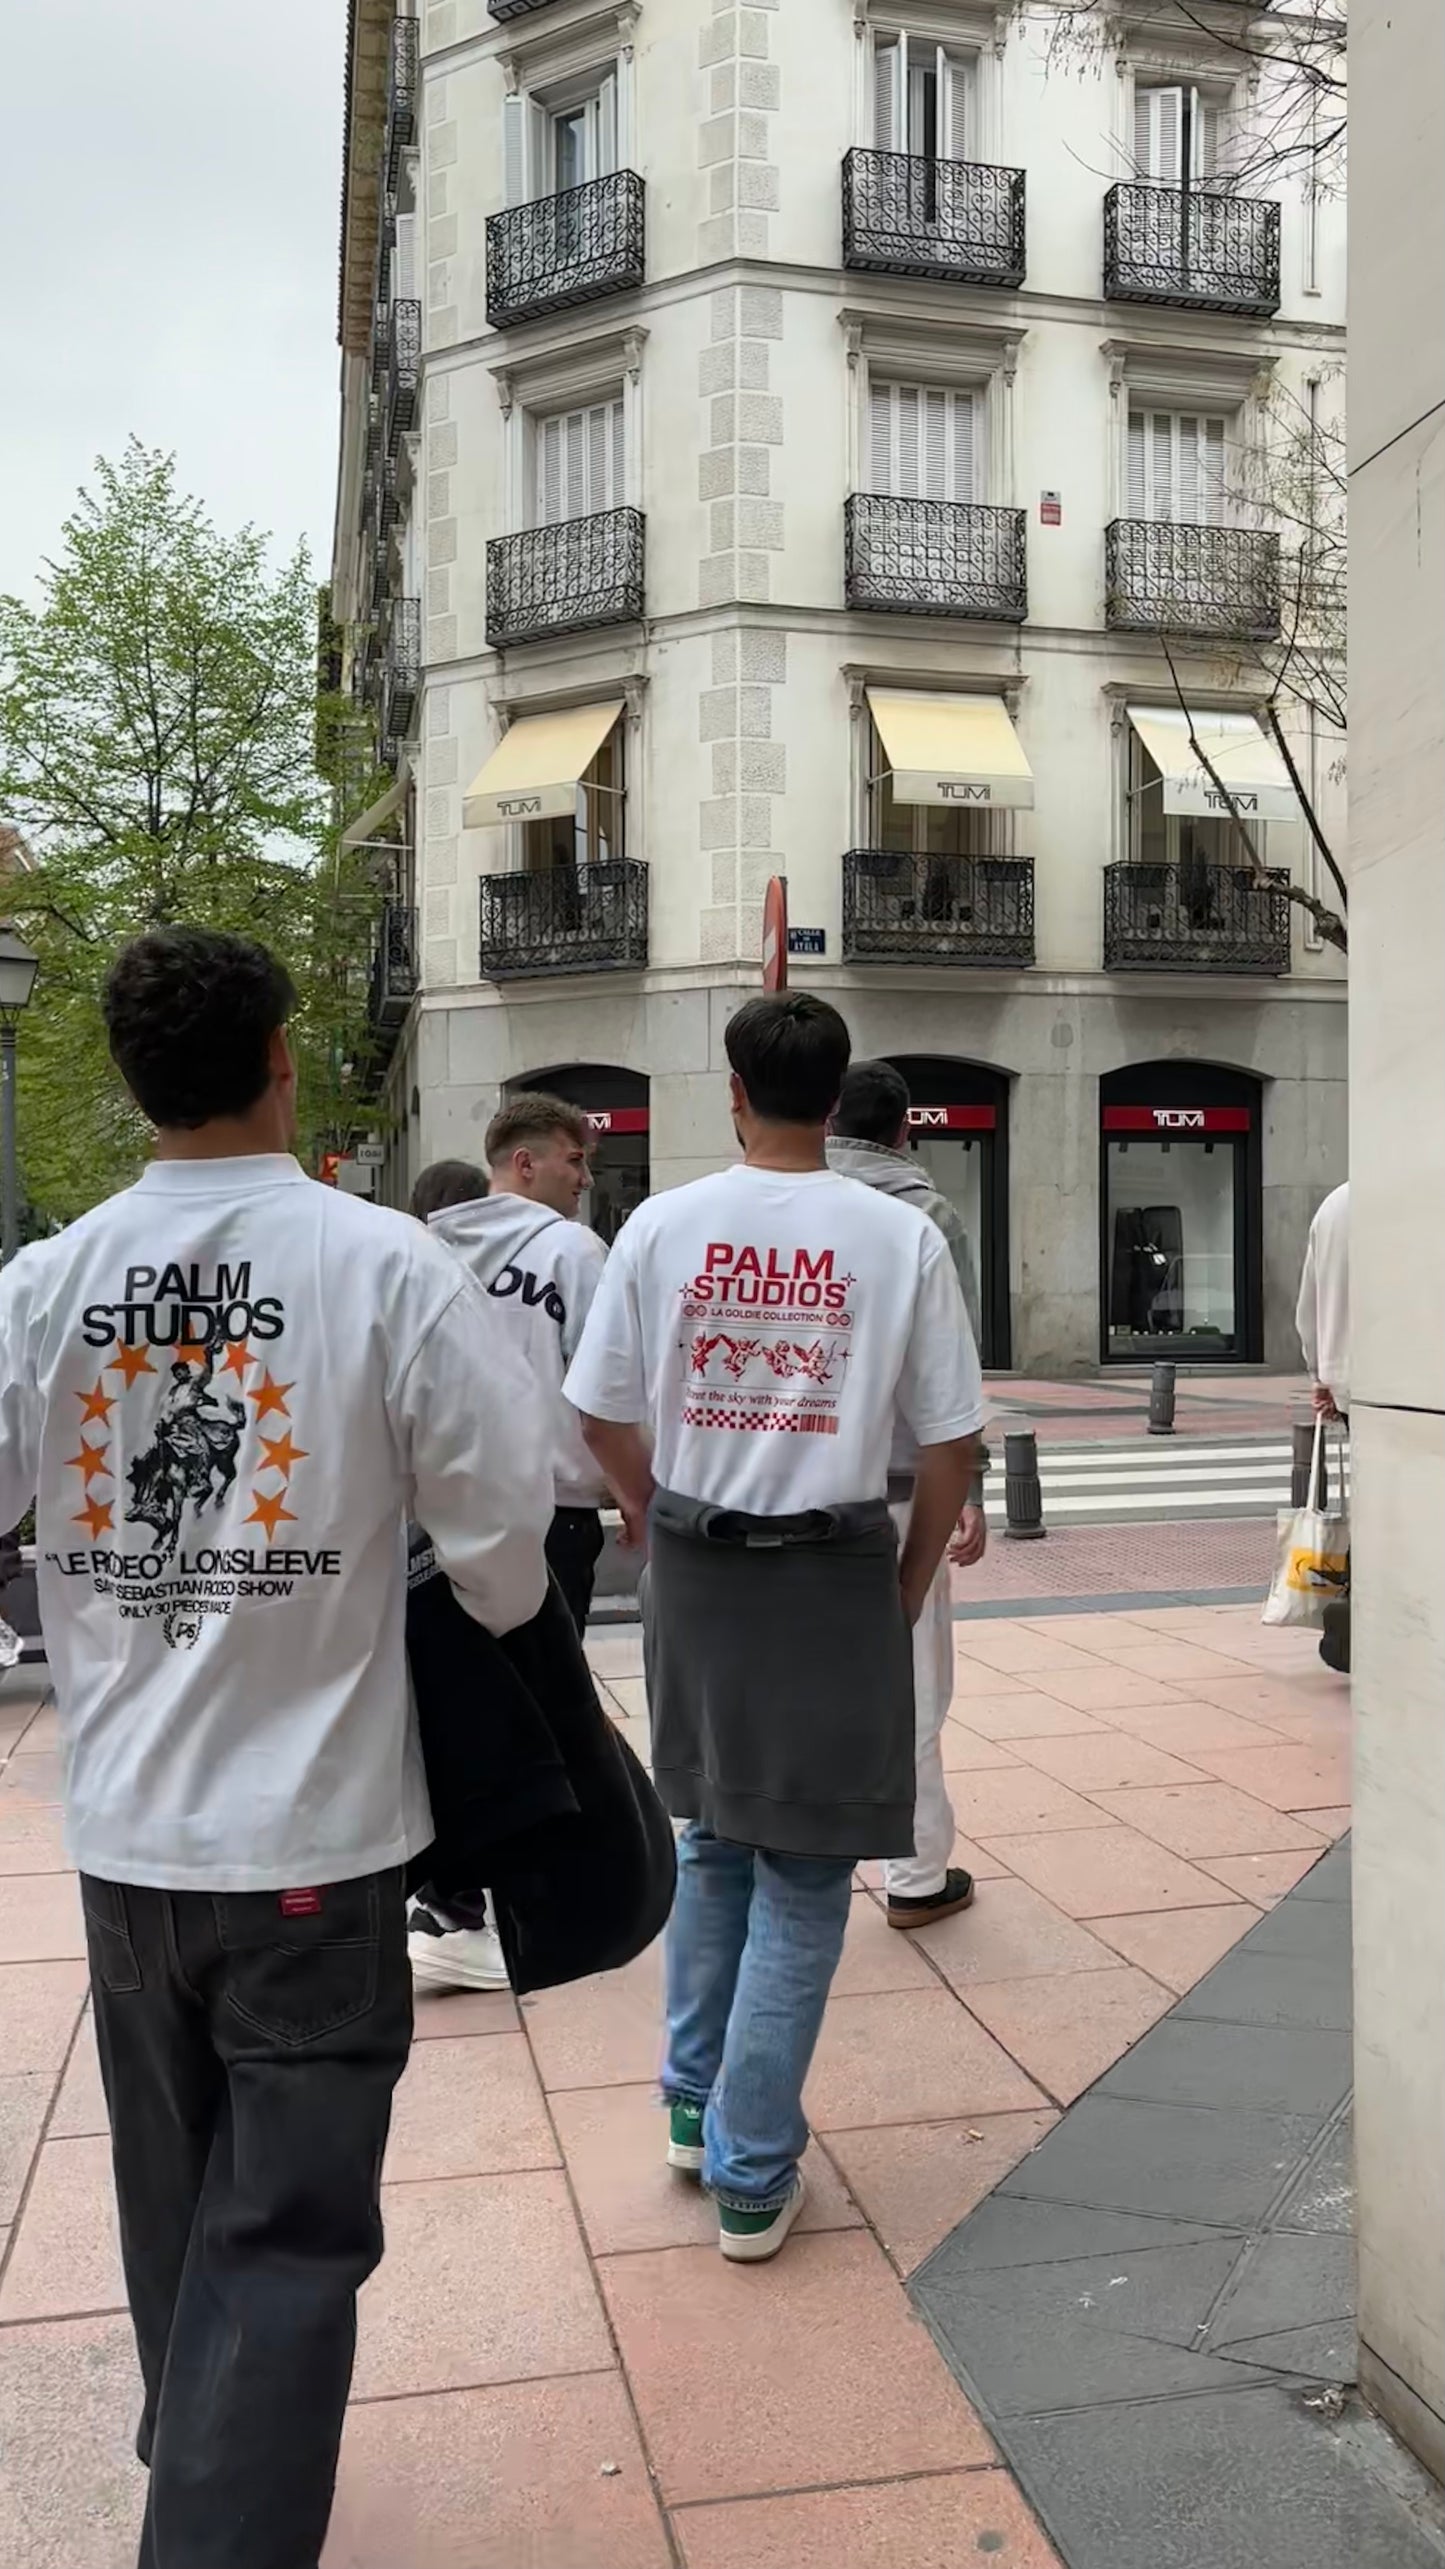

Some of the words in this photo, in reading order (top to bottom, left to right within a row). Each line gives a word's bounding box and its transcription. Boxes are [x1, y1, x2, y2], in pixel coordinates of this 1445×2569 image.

[937, 782, 991, 800] TUMI
[1204, 791, 1258, 811] TUMI
[497, 796, 541, 816] TUMI
[906, 1108, 948, 1125] UMI
[1153, 1109, 1205, 1127] TUMI
[705, 1243, 835, 1281] PALM
[124, 1261, 252, 1302] PALM
[694, 1275, 847, 1309] STUDIOS
[82, 1298, 284, 1347] STUDIOS
[711, 1308, 723, 1318] LA
[725, 1309, 761, 1321] GOLDIE
[762, 1310, 825, 1323] COLLECTION
[727, 1391, 748, 1406] sky
[797, 1395, 837, 1409] dreams
[180, 1548, 342, 1575] LONGSLEEVE
[116, 1580, 202, 1601] SEBASTIAN
[237, 1580, 294, 1597] SHOW
[119, 1604, 153, 1619] ONLY
[154, 1602, 171, 1615] 30
